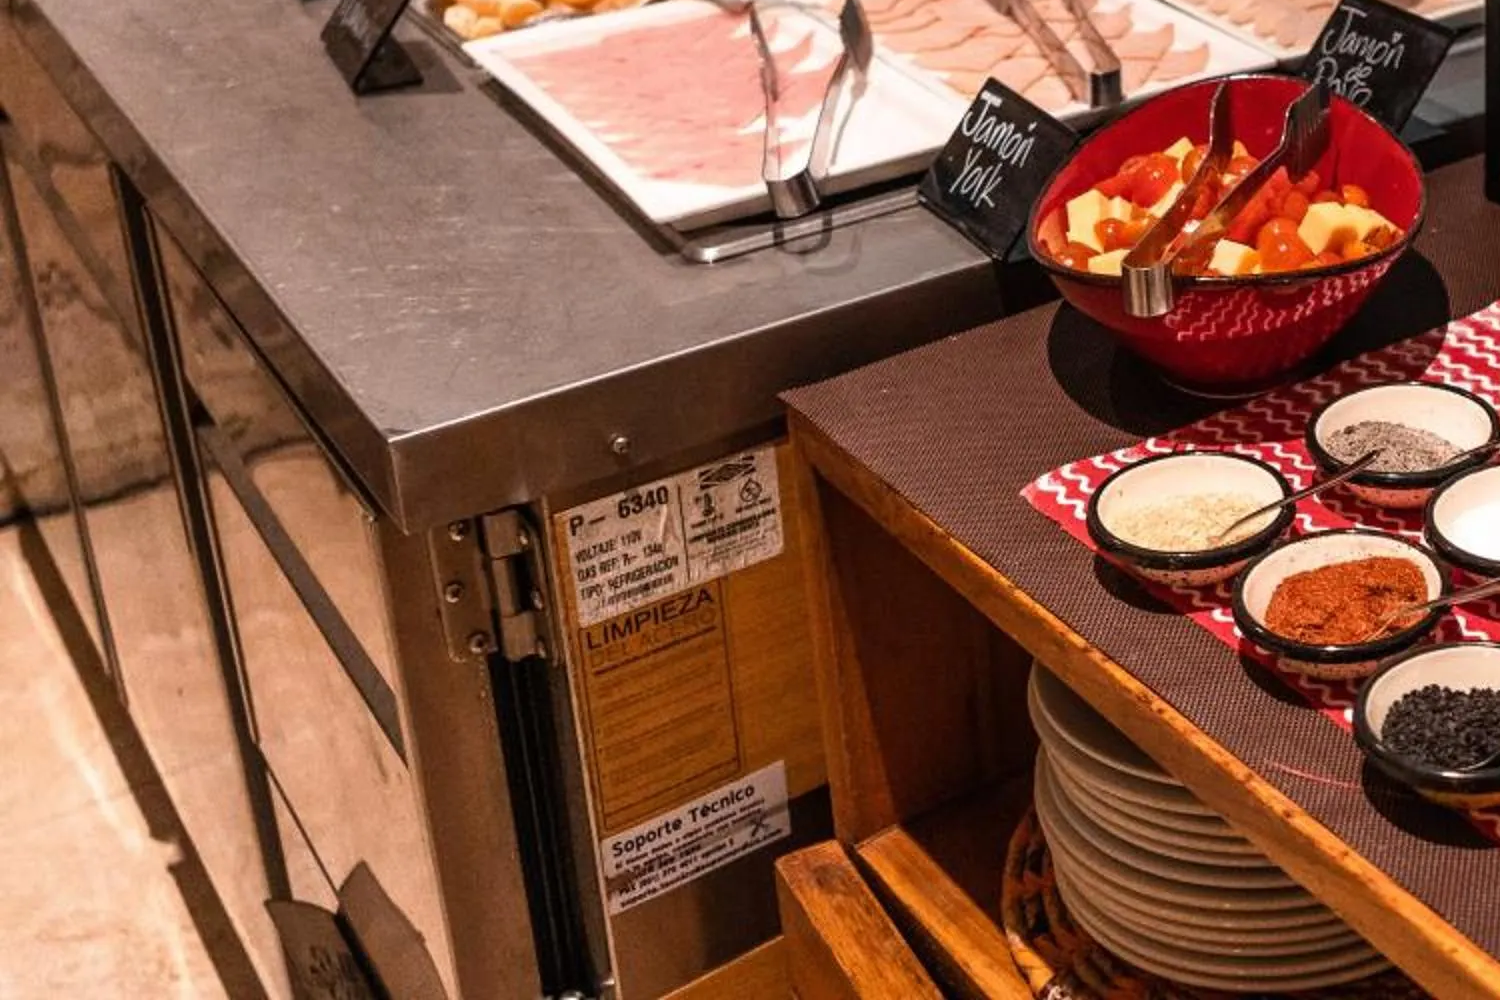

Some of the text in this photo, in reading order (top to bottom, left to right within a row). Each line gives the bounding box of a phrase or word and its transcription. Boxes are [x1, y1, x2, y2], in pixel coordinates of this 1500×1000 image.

[1321, 5, 1405, 70] Jamón
[961, 89, 1038, 169] Jamón
[617, 485, 669, 519] 6340
[586, 588, 714, 650] LIMPIEZA
[612, 818, 683, 858] Soporte
